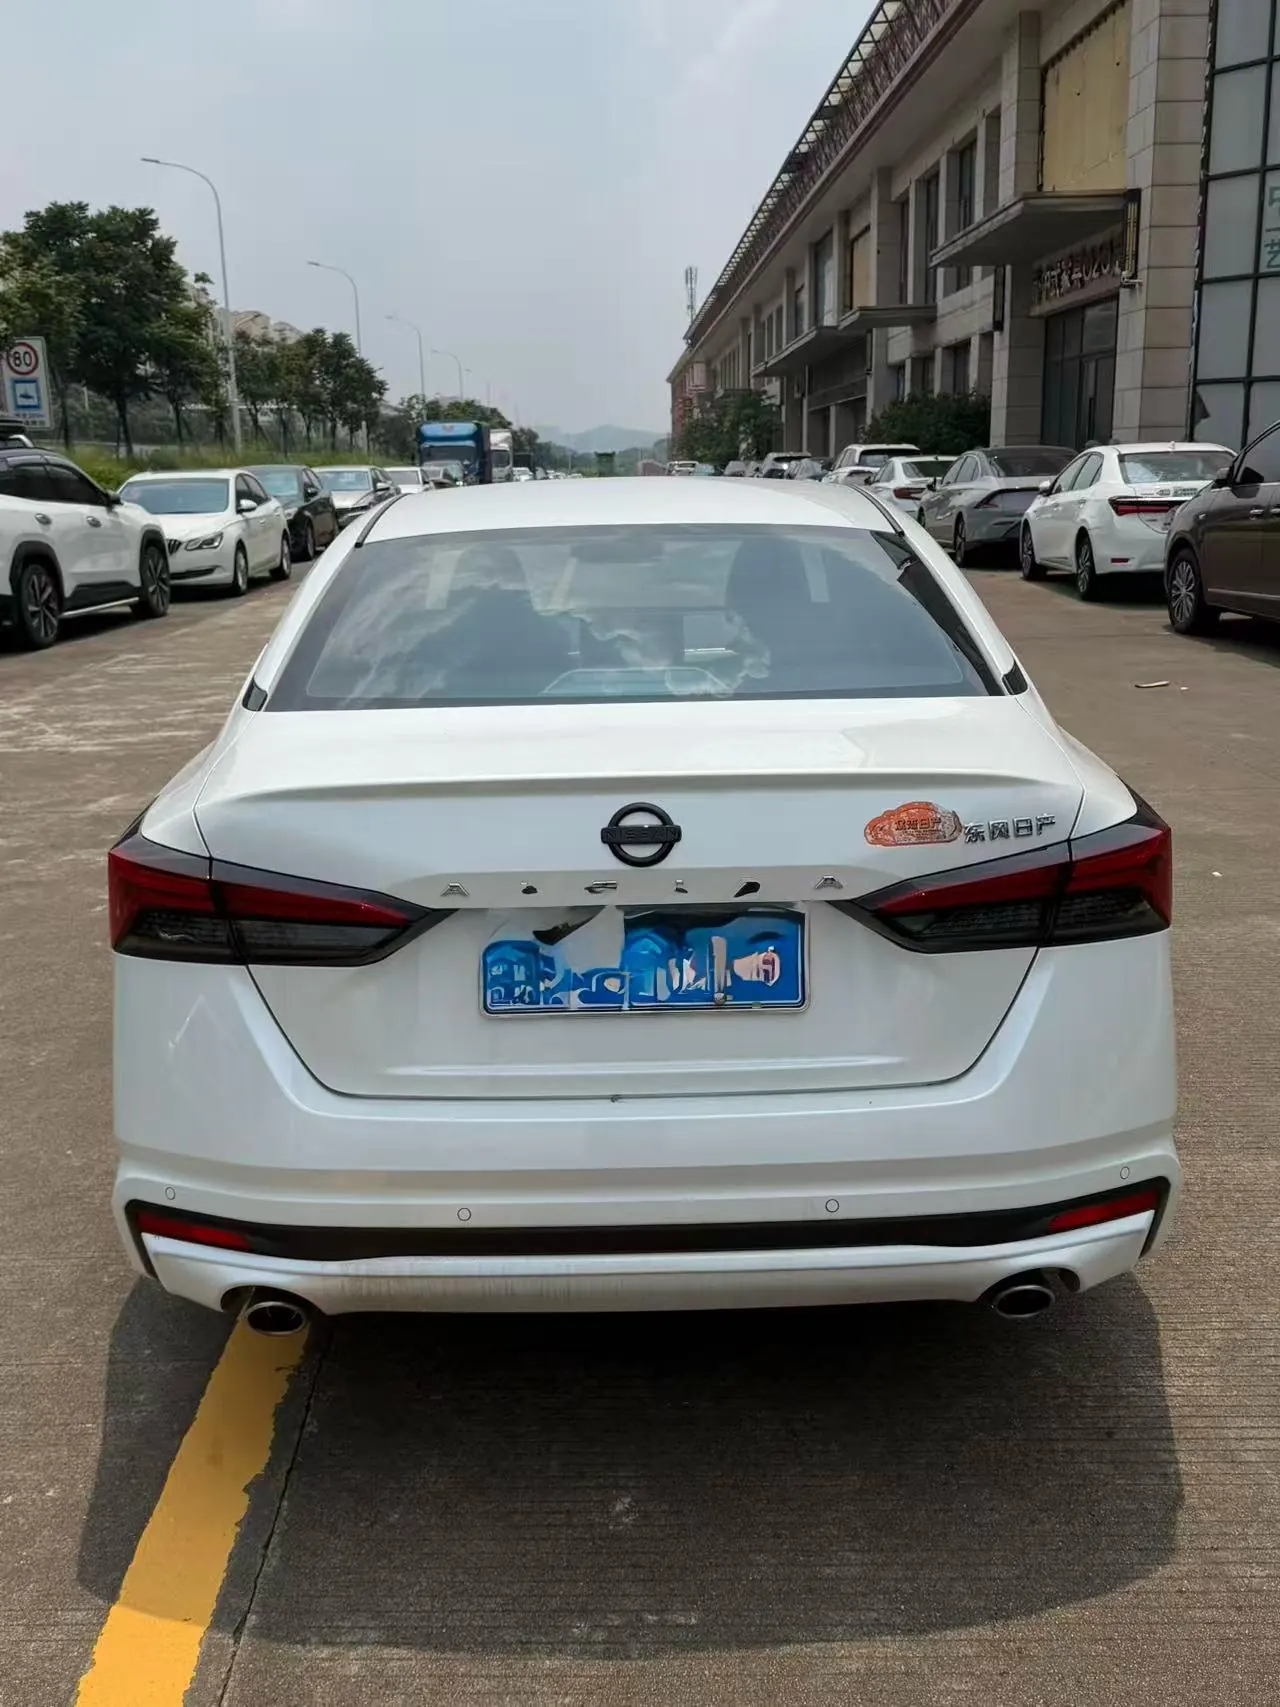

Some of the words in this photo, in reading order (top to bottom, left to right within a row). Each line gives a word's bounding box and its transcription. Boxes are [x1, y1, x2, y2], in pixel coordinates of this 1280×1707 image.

[13, 351, 32, 367] 80
[602, 827, 681, 842] NISSAN
[964, 813, 1056, 844] 东风日产
